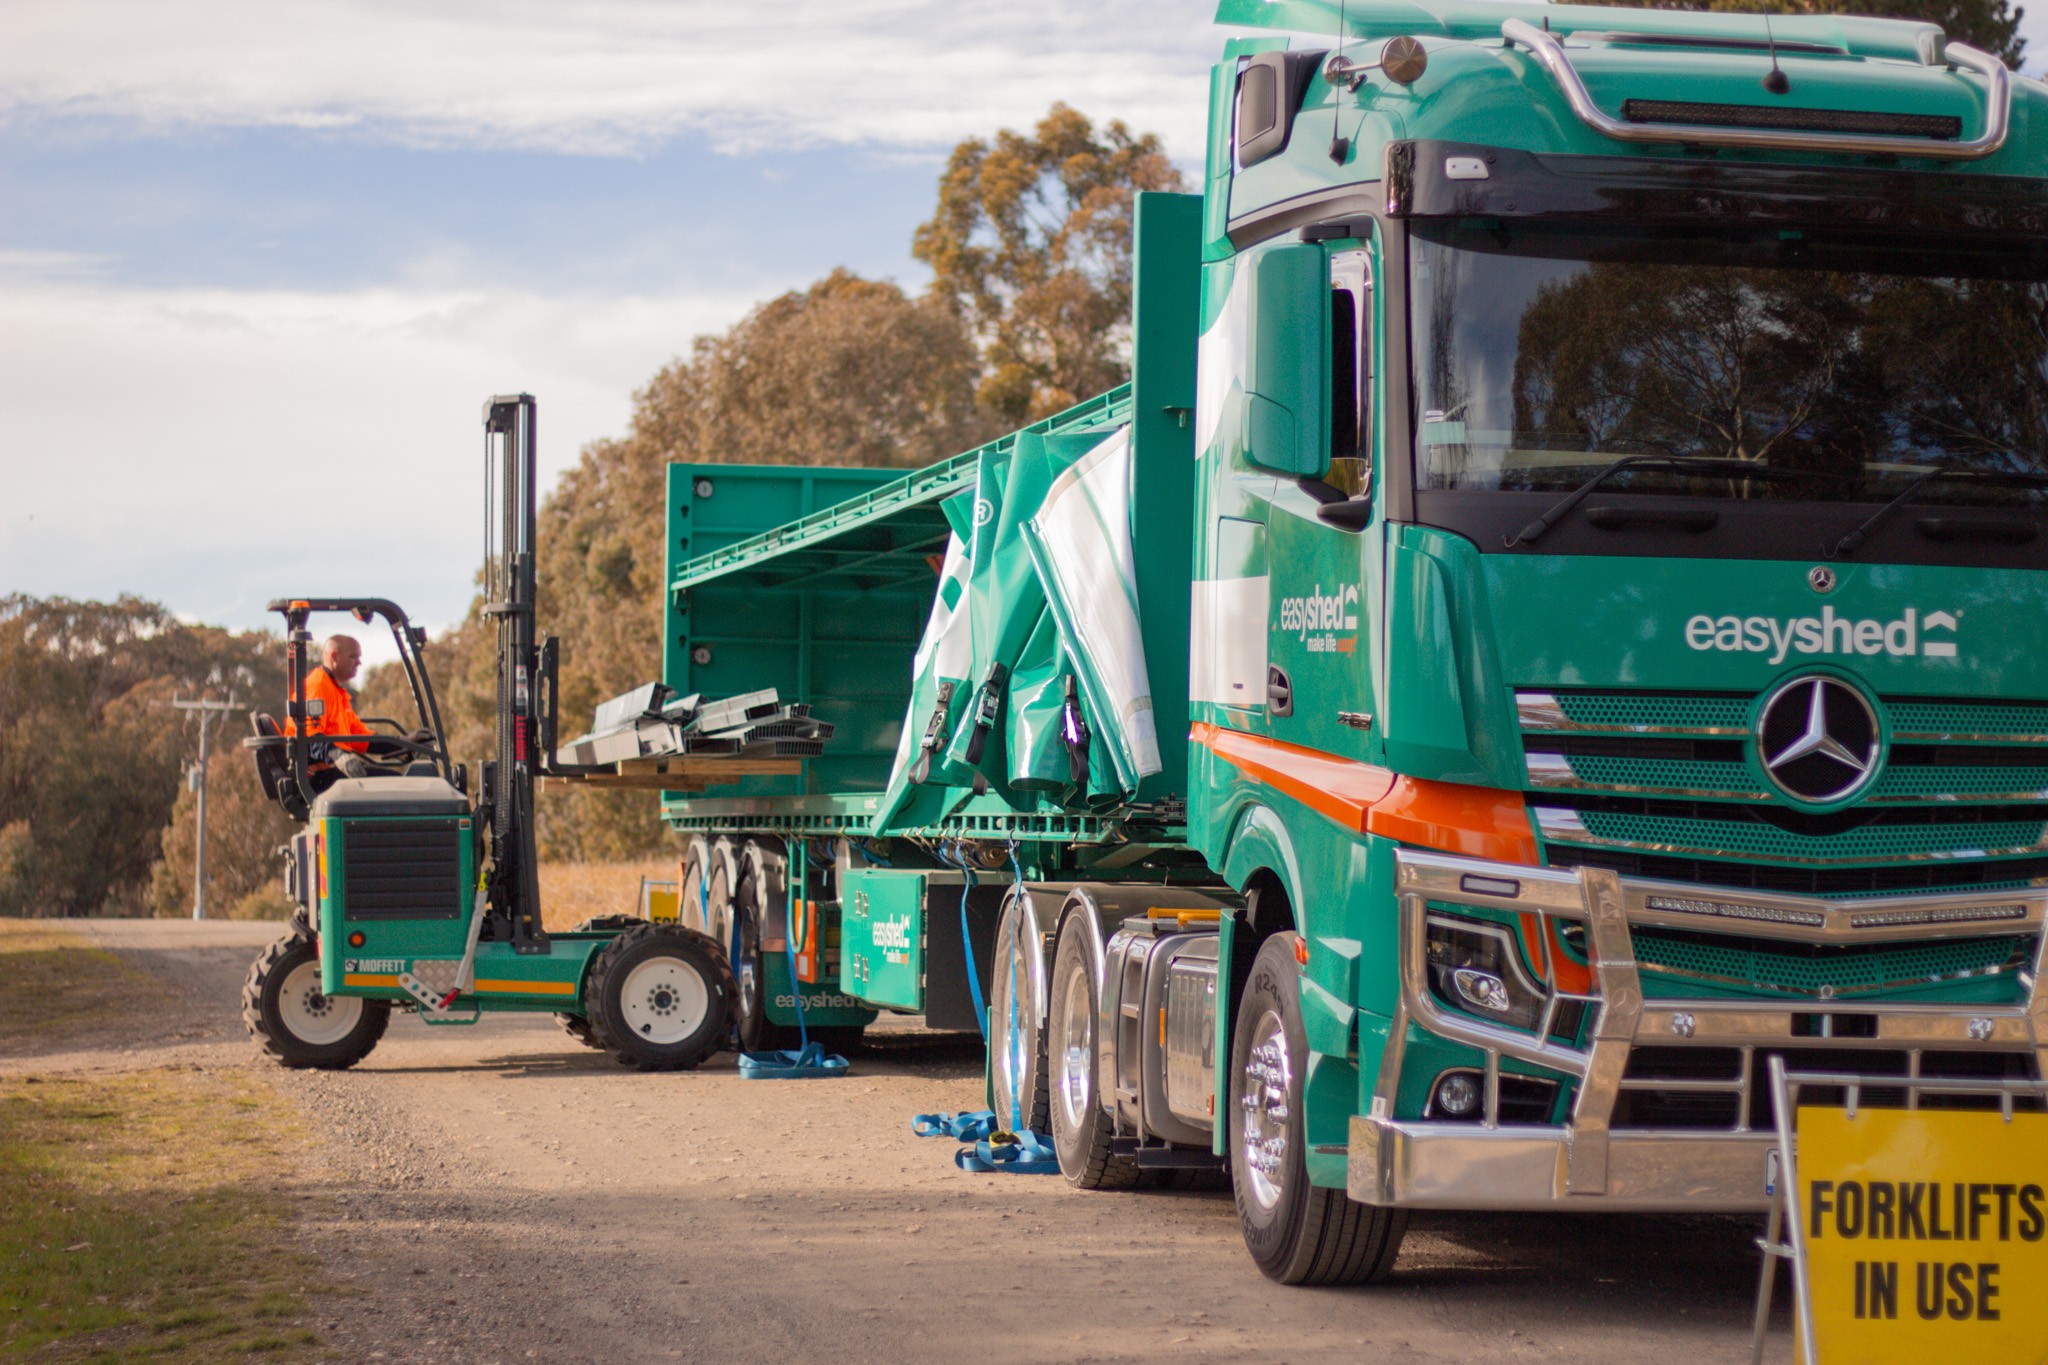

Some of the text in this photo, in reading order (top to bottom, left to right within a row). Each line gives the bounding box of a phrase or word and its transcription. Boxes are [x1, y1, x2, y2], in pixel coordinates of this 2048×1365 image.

[1281, 583, 1344, 642] easyshed
[1685, 605, 1916, 665] easyshed
[1307, 633, 1325, 652] make
[1325, 633, 1337, 652] life
[872, 913, 905, 955] easyshed
[359, 959, 407, 973] MOFFETT
[1810, 1180, 2046, 1243] FORKLIFTS
[1854, 1261, 2001, 1322] IN USE
